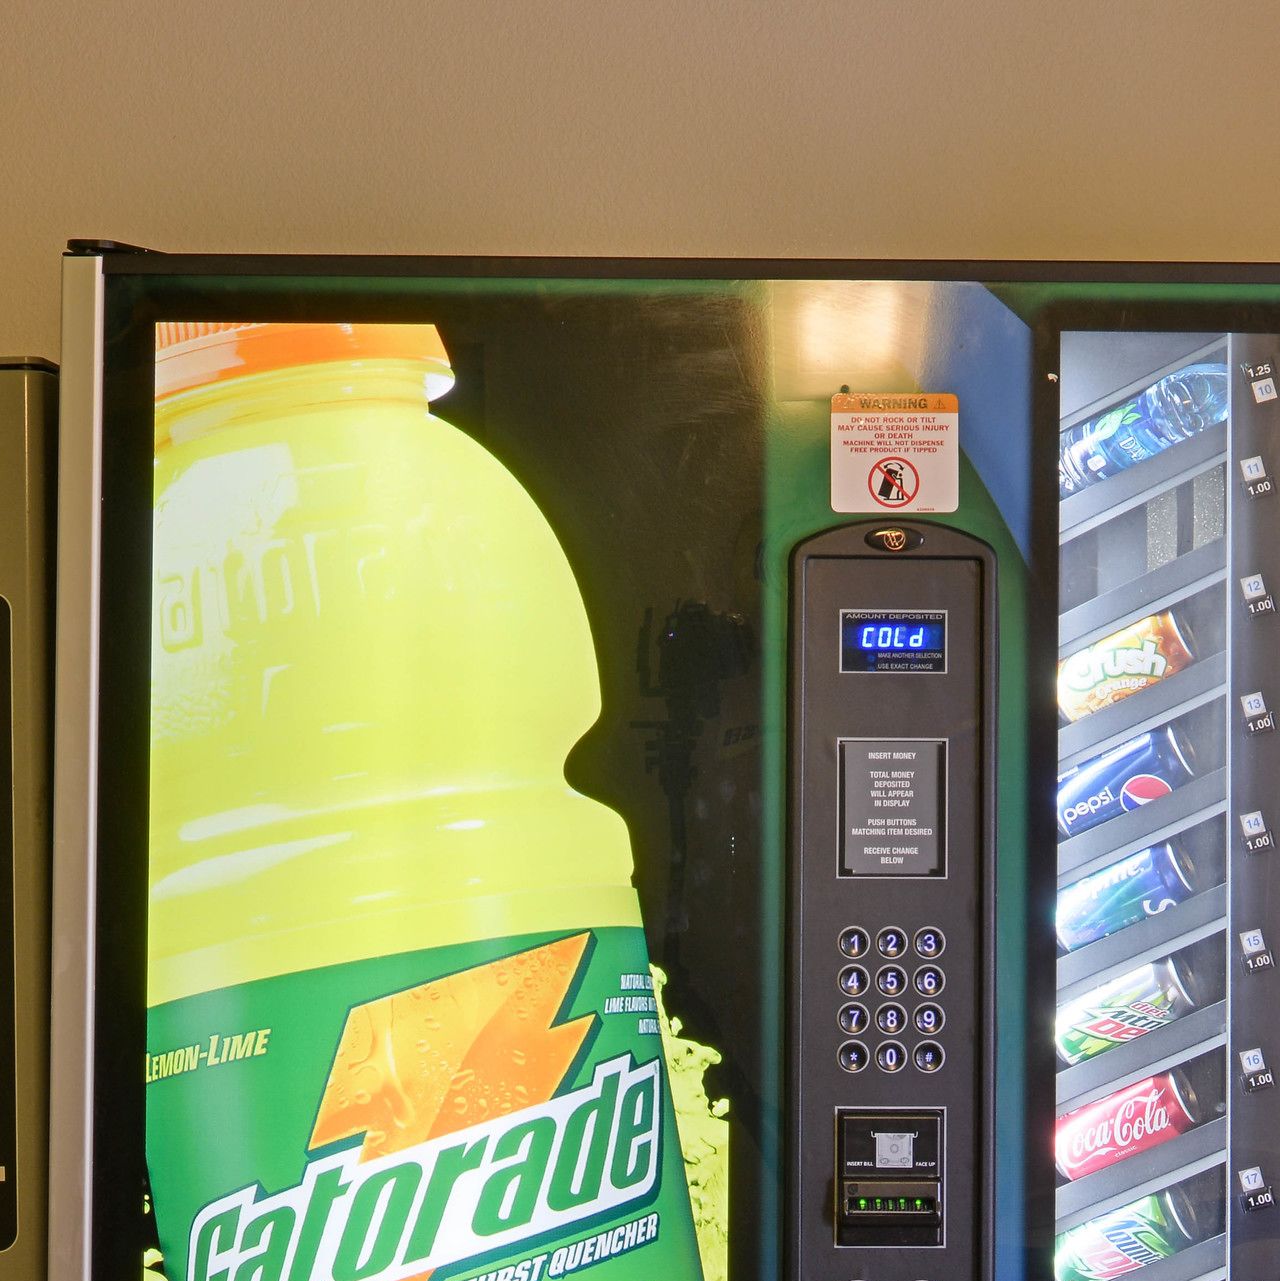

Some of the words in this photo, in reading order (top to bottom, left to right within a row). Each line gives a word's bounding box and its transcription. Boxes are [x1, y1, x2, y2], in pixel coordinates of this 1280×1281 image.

[1245, 363, 1270, 377] 1.25
[1259, 384, 1272, 395] 10
[860, 398, 928, 409] WARNING
[865, 416, 880, 424] NOT
[883, 416, 904, 424] ROCK
[907, 416, 917, 424] OR
[921, 416, 935, 424] TILT
[838, 424, 854, 432] MAY
[858, 424, 883, 432] CAUSE
[886, 424, 919, 432] SERIOUS
[923, 424, 949, 432] INJURY
[874, 432, 885, 440] OR
[888, 432, 912, 440] DEATH
[913, 446, 937, 454] TIPPED
[1247, 463, 1259, 474] 11
[1248, 482, 1270, 495] 1.00
[1248, 581, 1261, 592] 12
[1247, 598, 1272, 613] 1.00
[1248, 699, 1261, 710] 13
[1247, 718, 1270, 731] 1.00
[1064, 786, 1115, 825] pepsi
[1246, 818, 1260, 828] 14
[1245, 835, 1269, 849] 1.00
[146, 1029, 271, 1083] LEMON-LIME
[549, 1214, 659, 1279] QUENCHER
